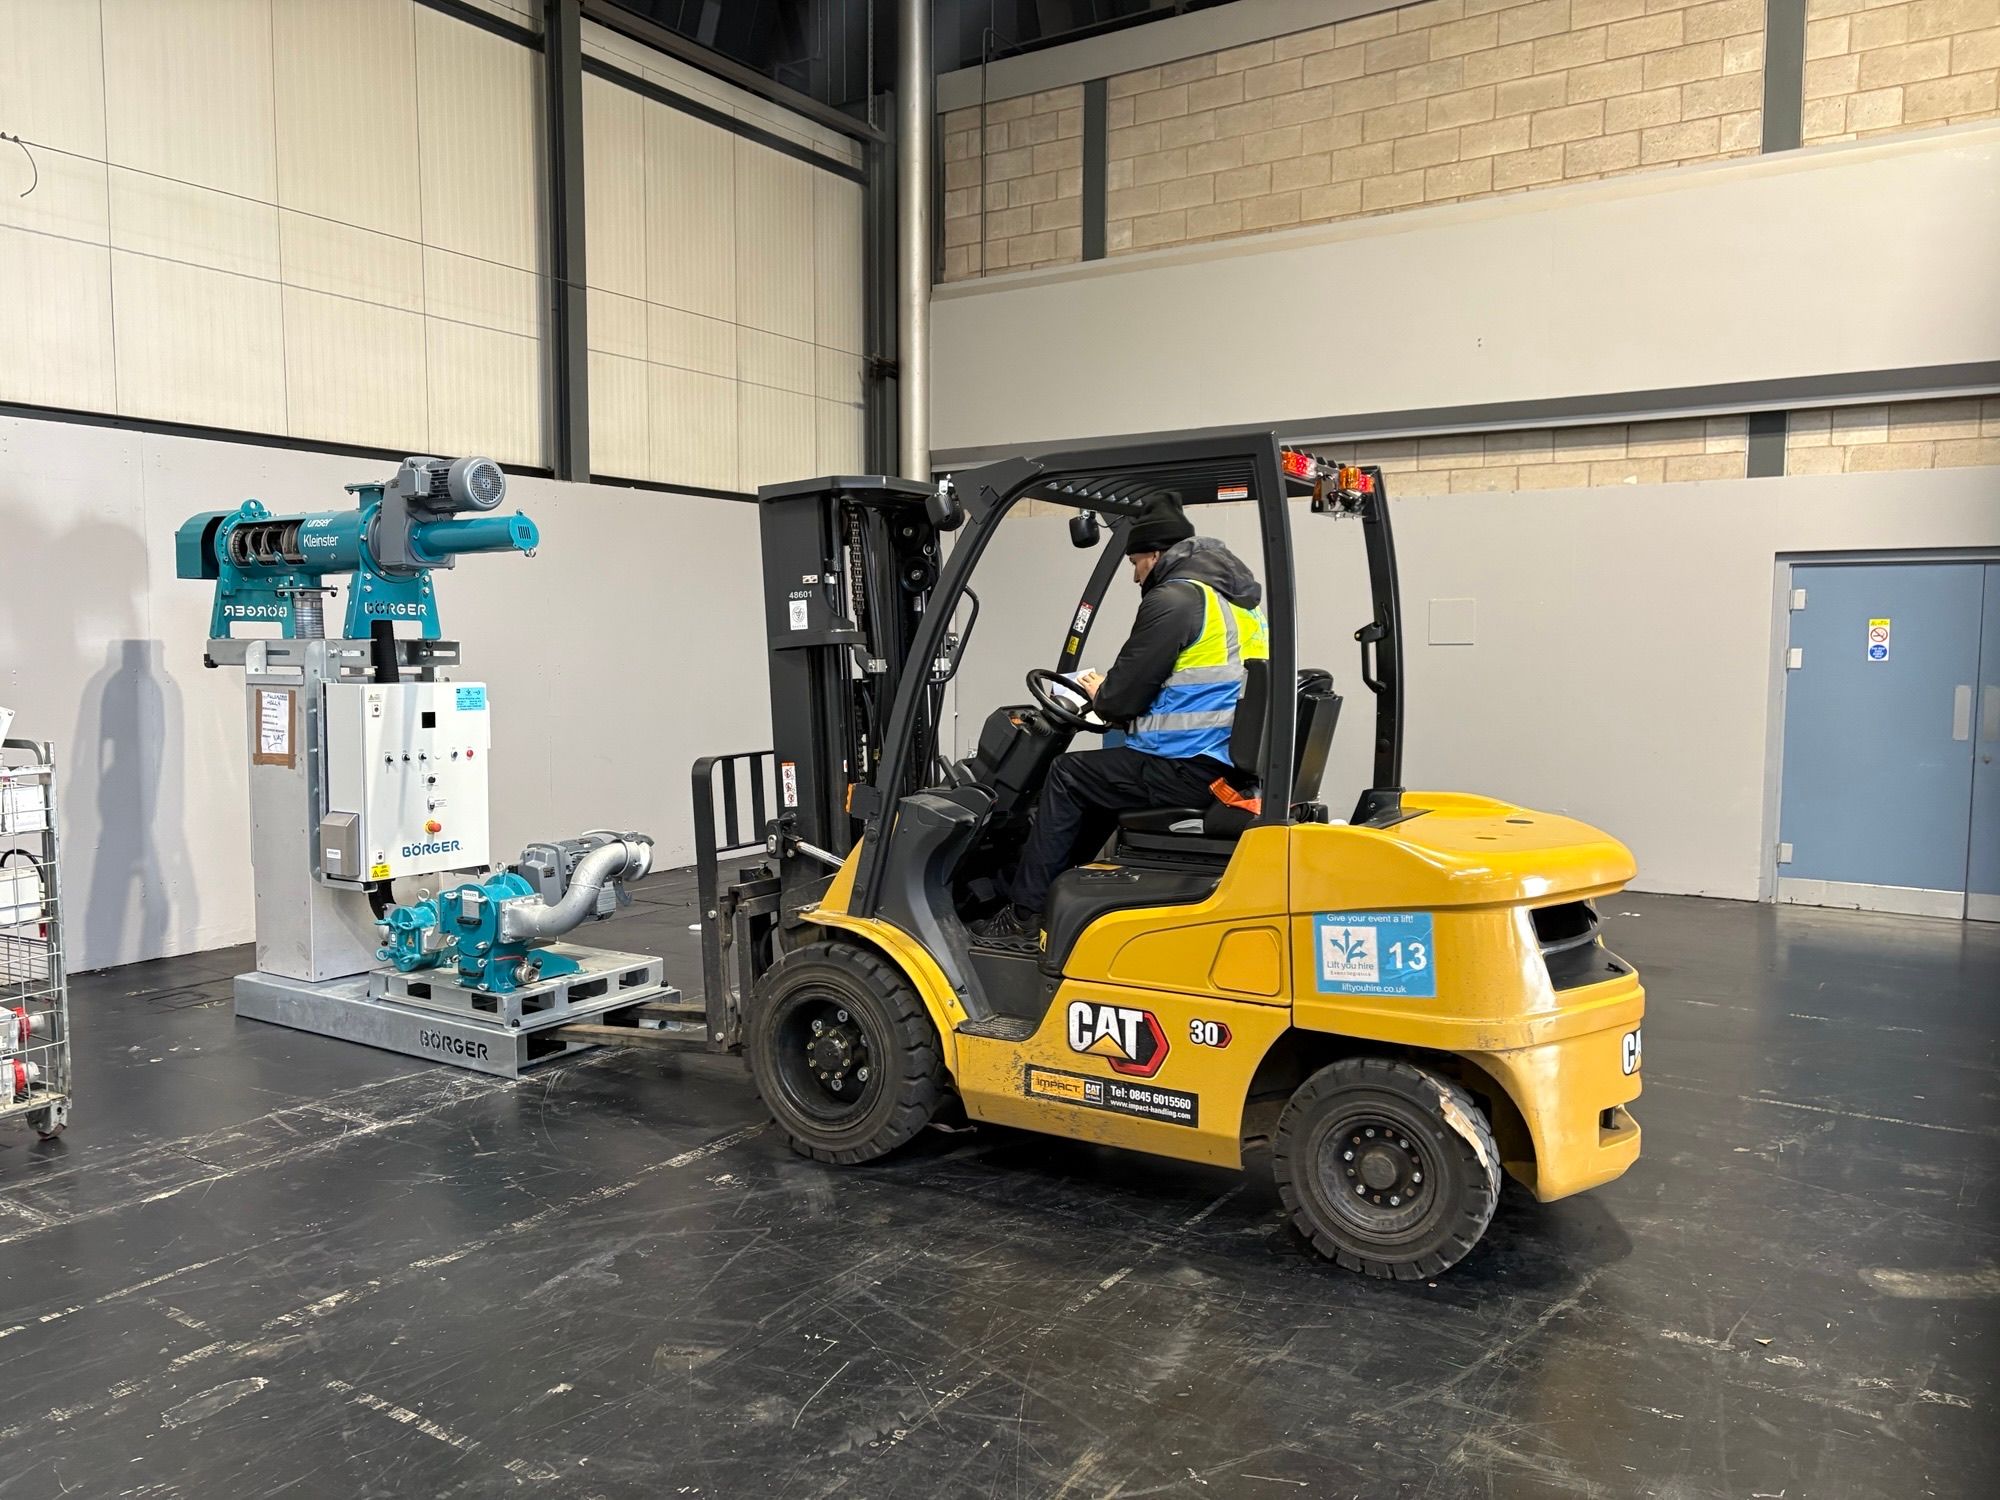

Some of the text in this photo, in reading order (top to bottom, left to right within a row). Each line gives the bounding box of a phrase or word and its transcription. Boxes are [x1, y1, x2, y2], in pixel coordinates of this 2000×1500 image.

[307, 518, 333, 528] unser
[303, 533, 339, 548] Kleinster
[788, 590, 812, 599] 48601
[364, 600, 428, 616] BÖRGER
[402, 840, 462, 858] BÖRGER
[1327, 914, 1345, 922] Give
[1348, 914, 1366, 924] your
[1368, 914, 1391, 923] event
[1400, 914, 1414, 923] lift!
[1389, 941, 1428, 971] 13
[1327, 960, 1374, 971] Lift you hire
[1342, 983, 1406, 994] liftyouhire.co.uk
[1068, 1001, 1144, 1060] CAT
[1190, 1020, 1218, 1046] 30
[419, 1028, 489, 1061] BÖRGER
[1085, 1083, 1101, 1096] CAT
[1110, 1084, 1191, 1110] Tel: 0845 6015560
[1110, 1098, 1191, 1120] www.impact-handling.com
